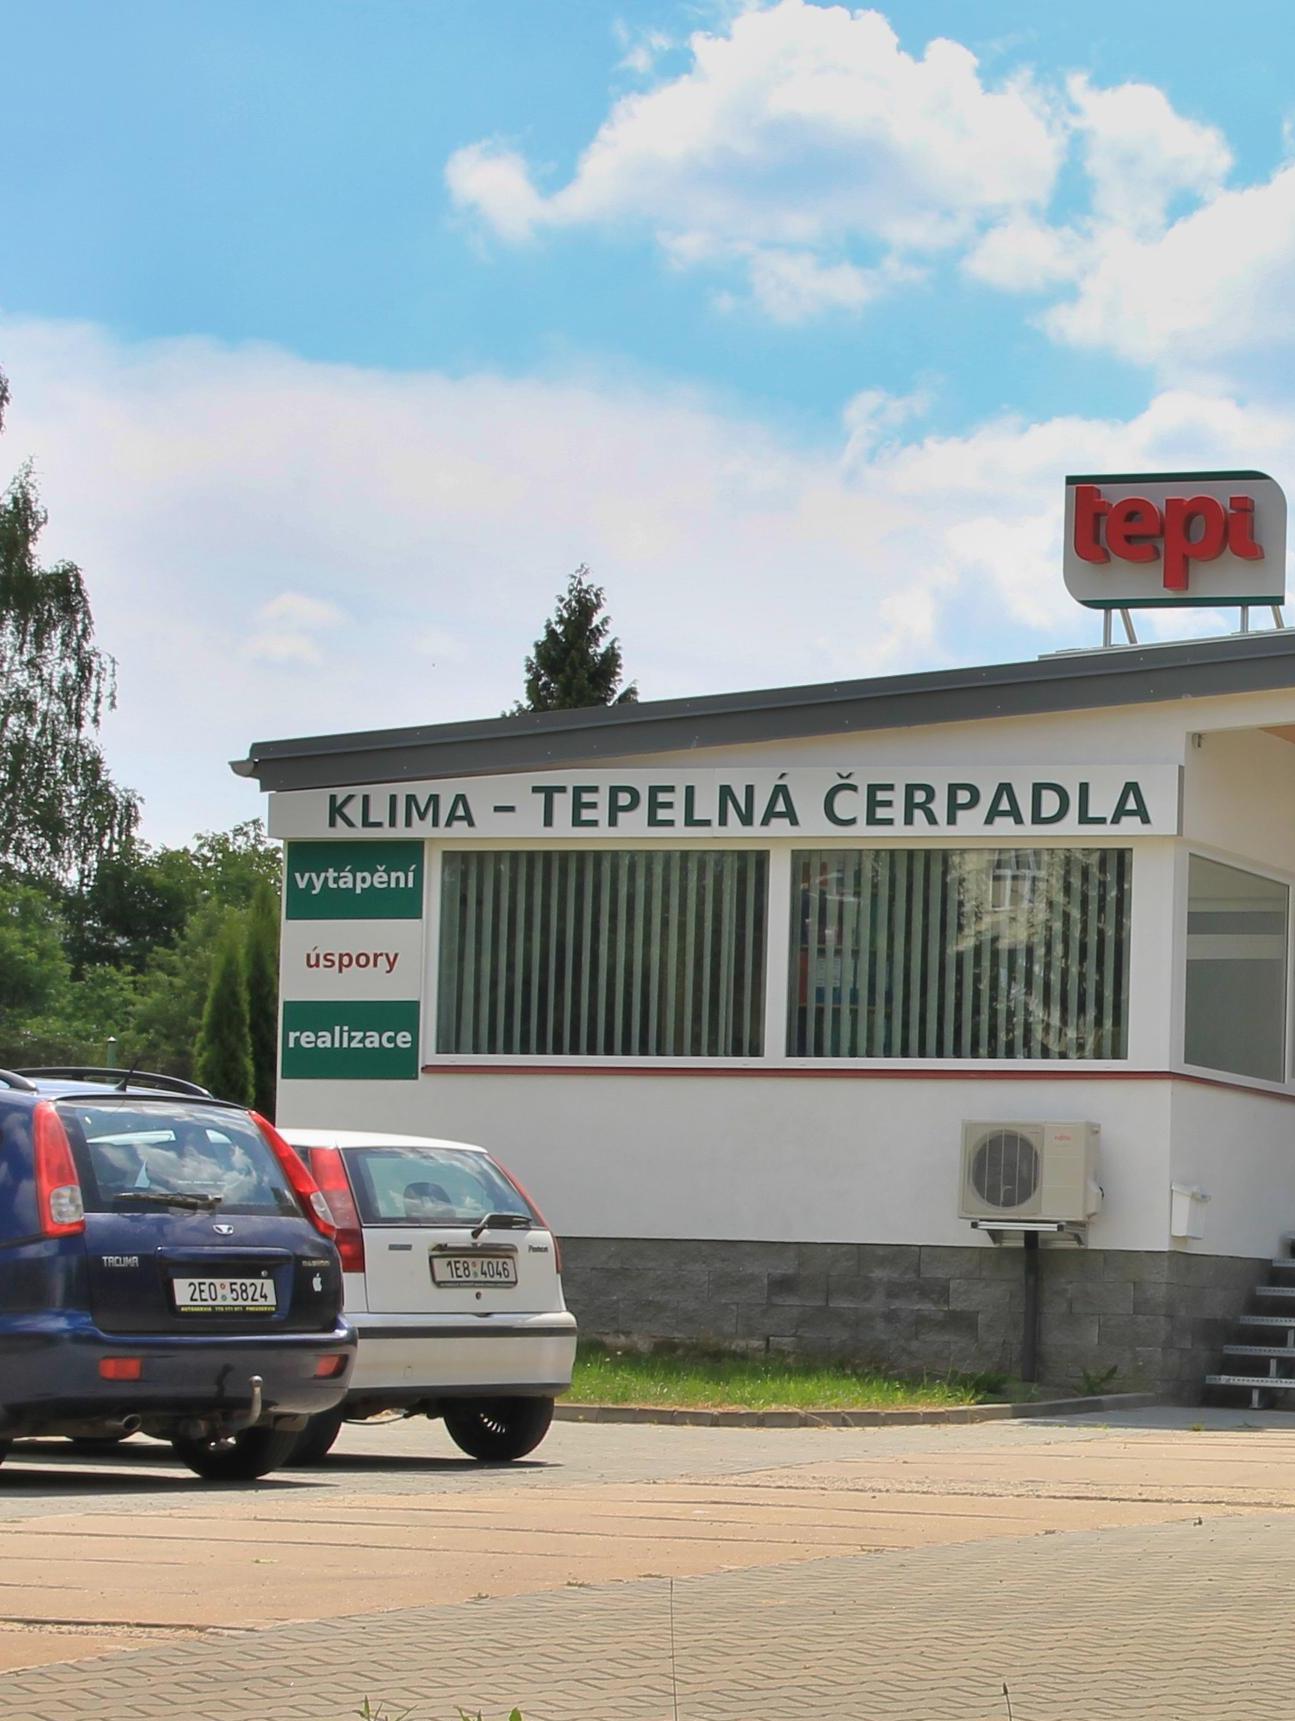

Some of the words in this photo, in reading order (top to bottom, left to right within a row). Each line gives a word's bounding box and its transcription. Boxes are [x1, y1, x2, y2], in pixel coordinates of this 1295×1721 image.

[1073, 484, 1265, 591] tepi
[328, 793, 477, 828] KLIMA
[531, 772, 800, 828] TEPELNÁ
[823, 772, 1152, 827] ČERPADLA
[294, 864, 417, 895] vytápění
[305, 946, 399, 974] úspory
[288, 1025, 412, 1049] realizace
[446, 1260, 471, 1279] 1E8
[480, 1260, 510, 1279] 4046
[229, 1281, 268, 1302] 5824
